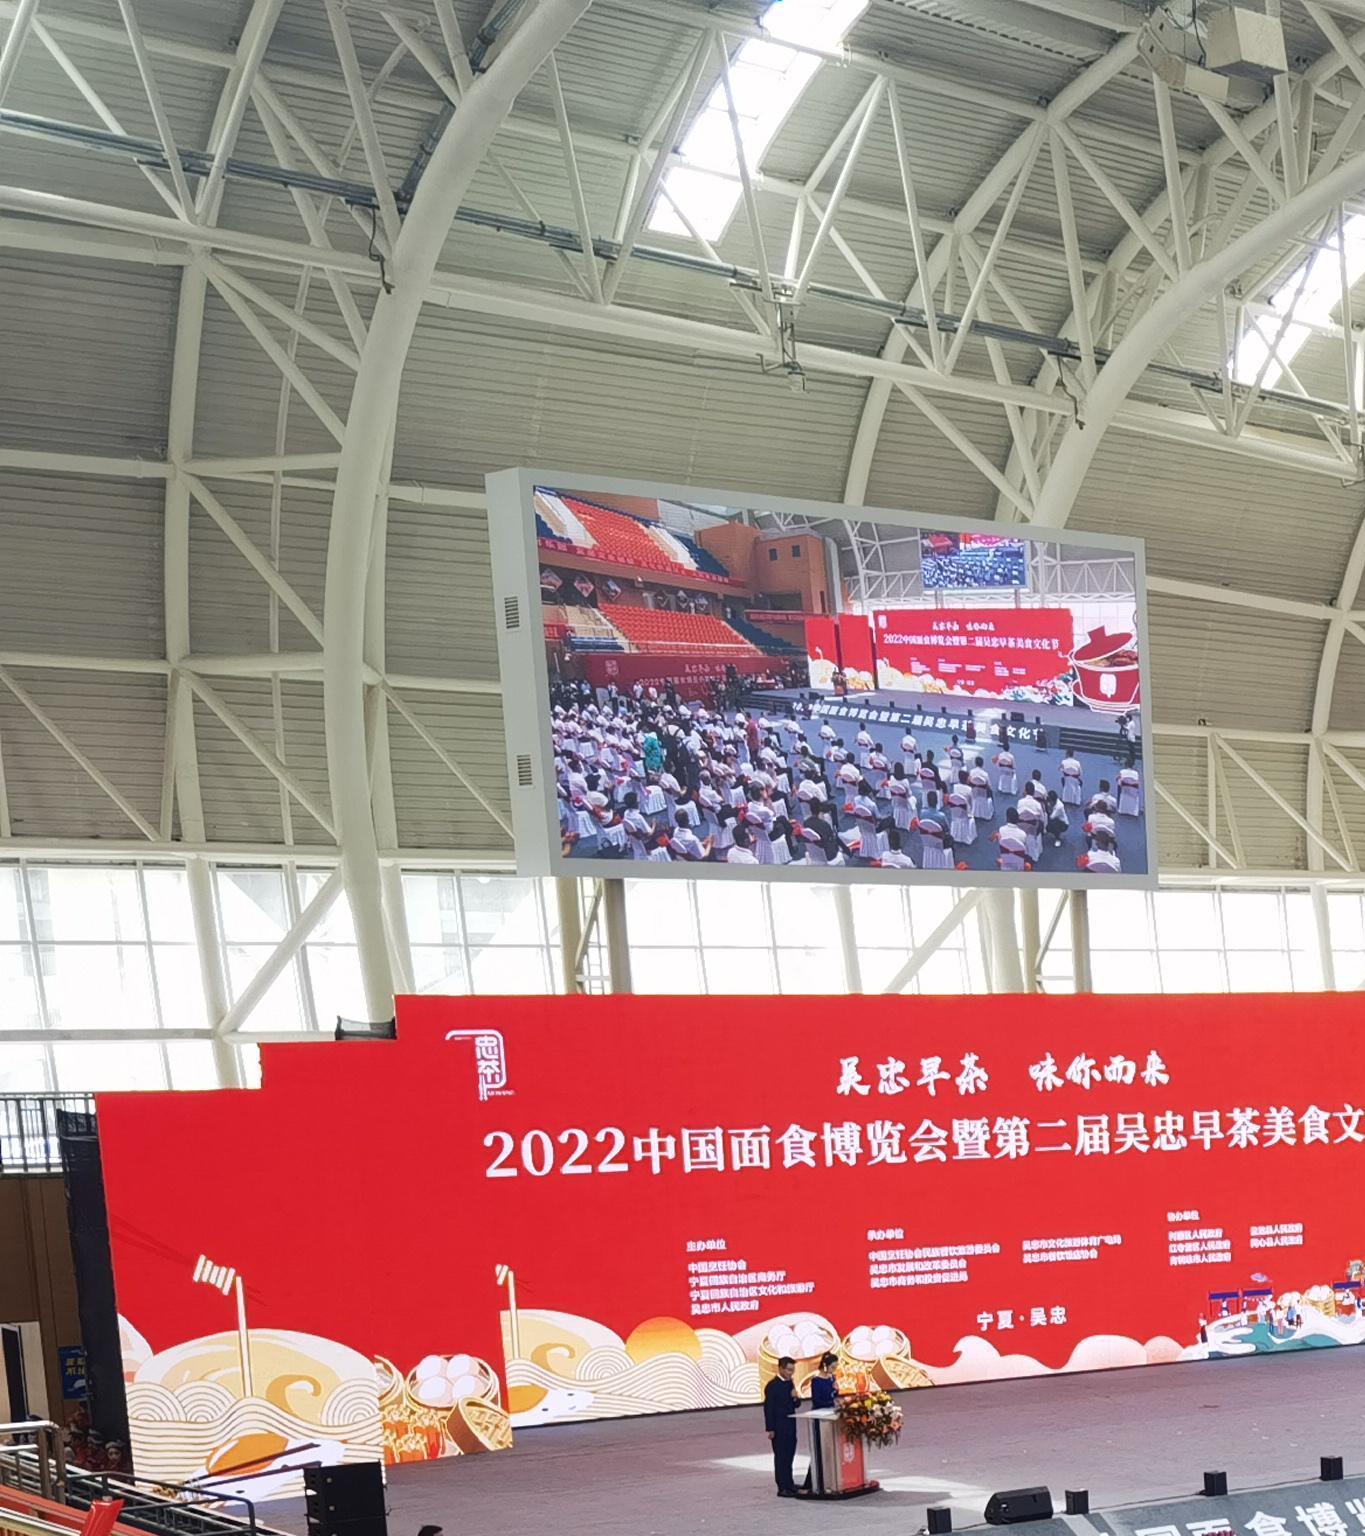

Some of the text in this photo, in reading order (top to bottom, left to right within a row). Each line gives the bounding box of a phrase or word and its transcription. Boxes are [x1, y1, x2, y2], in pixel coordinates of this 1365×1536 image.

[836, 1049, 1171, 1097] 吴忠早茶 味你而来
